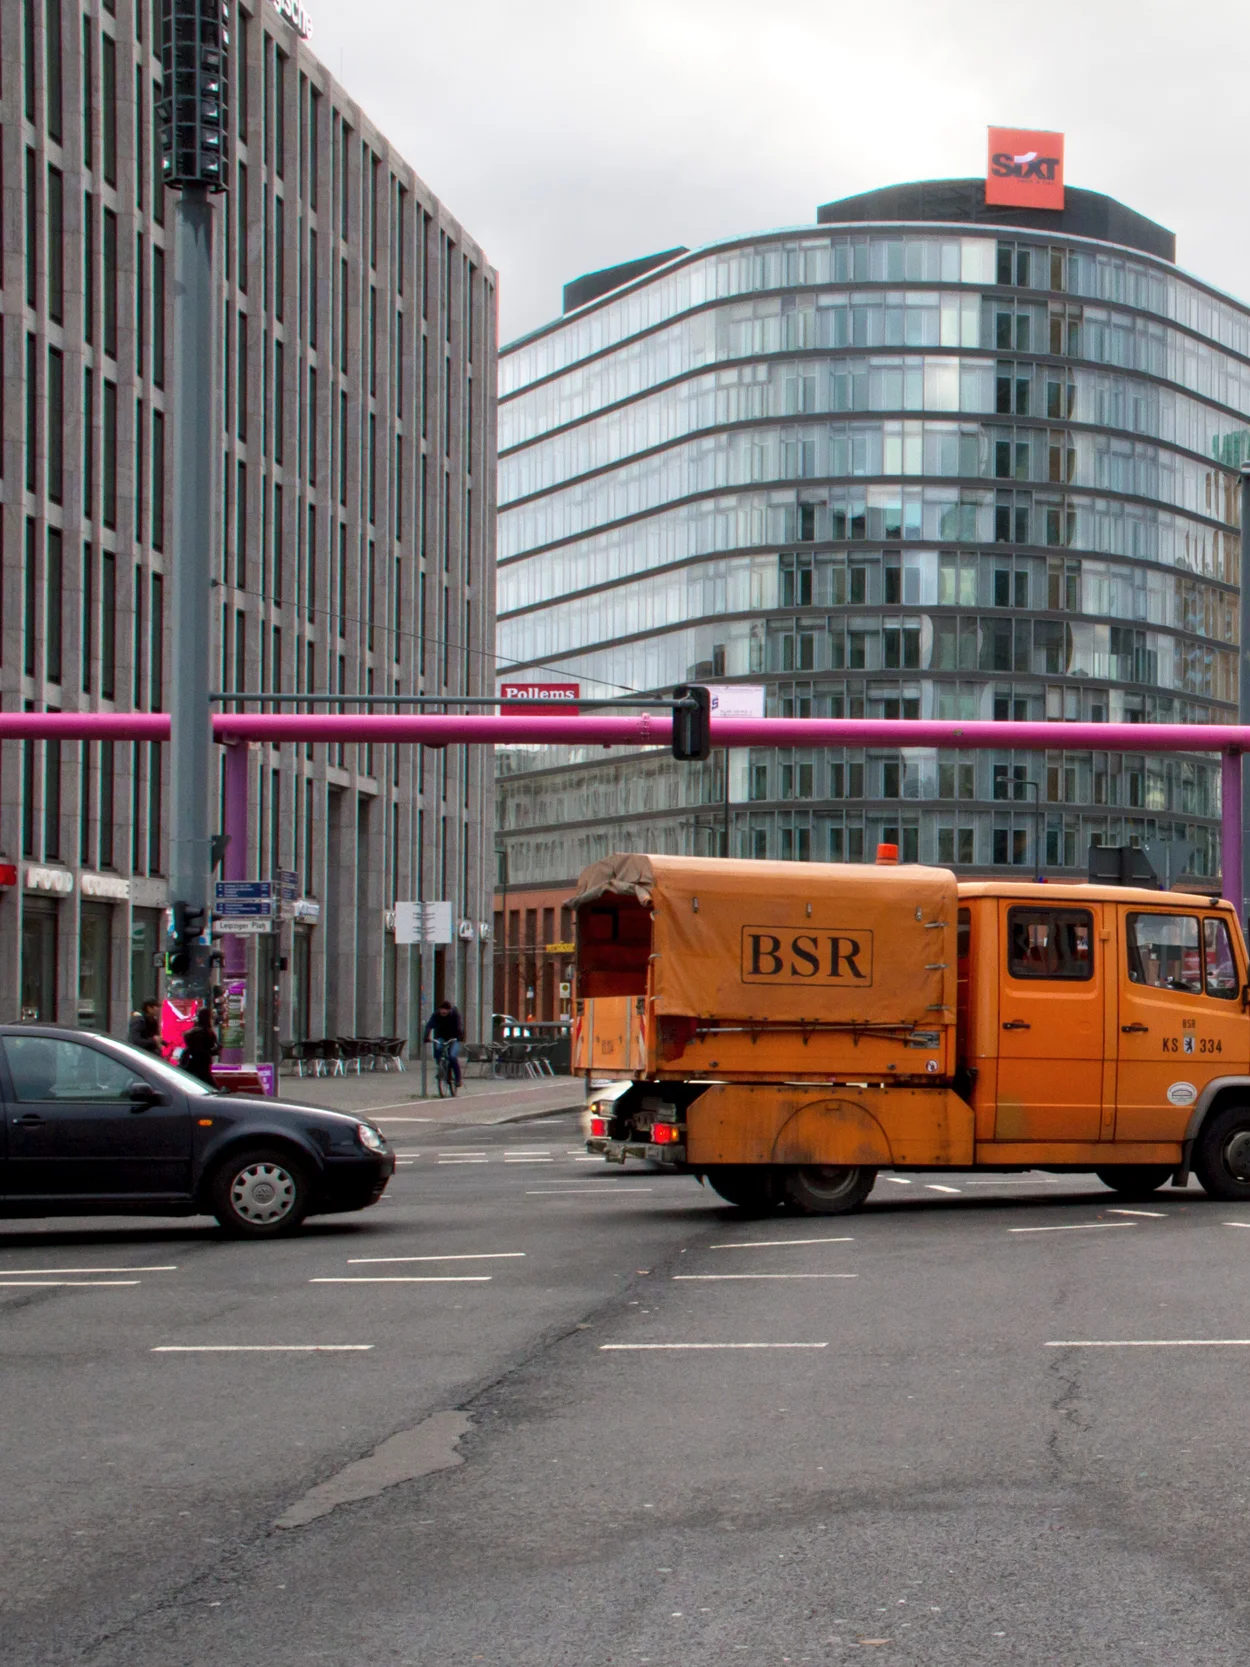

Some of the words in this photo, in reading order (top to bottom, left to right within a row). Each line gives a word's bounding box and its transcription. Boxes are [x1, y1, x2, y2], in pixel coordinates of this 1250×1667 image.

[505, 687, 575, 699] Pollems
[748, 934, 867, 978] BSR
[1182, 1019, 1196, 1029] BSR
[1162, 1037, 1178, 1052] KS
[1200, 1038, 1222, 1053] 334
